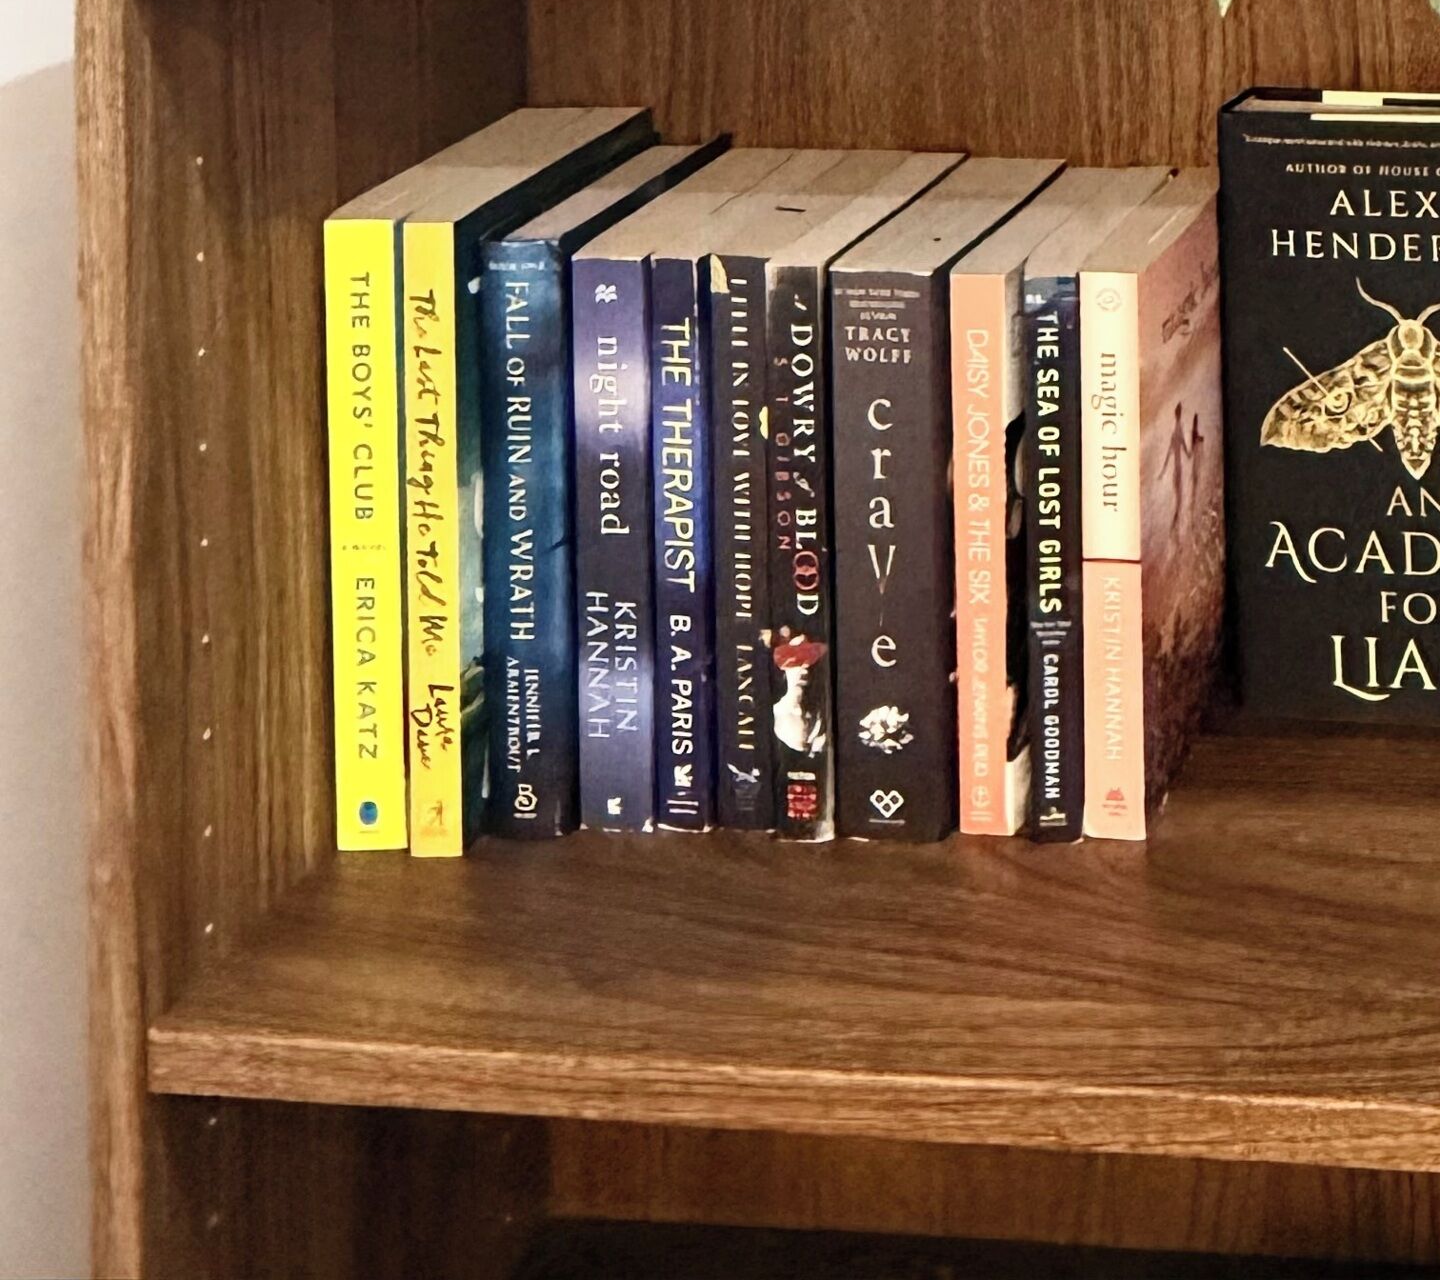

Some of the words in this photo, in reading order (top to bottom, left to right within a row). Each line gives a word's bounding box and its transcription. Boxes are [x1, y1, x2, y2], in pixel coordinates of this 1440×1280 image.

[350, 271, 371, 329] THE
[504, 281, 531, 349] FALL
[844, 326, 911, 343] TRACY
[1036, 310, 1060, 358] THE
[352, 344, 373, 428] BOYS'
[413, 344, 443, 406] Last
[506, 357, 526, 387] OF
[589, 336, 629, 433] night
[661, 317, 692, 387] THE
[845, 346, 912, 364] WOLFF
[966, 329, 990, 398] DAISY
[791, 324, 816, 463] DOWRY
[1037, 368, 1060, 416] SEA
[1090, 352, 1125, 434] magic
[506, 396, 532, 464] RUIN
[967, 405, 990, 489] JONES
[1038, 426, 1060, 457] OF
[353, 443, 374, 520] CLUB
[508, 473, 528, 521] AND
[599, 452, 630, 535] road
[662, 398, 696, 593] THERAPIST
[968, 494, 991, 512] &
[1038, 467, 1061, 529] LOST
[1101, 446, 1127, 512] hour
[968, 519, 991, 562] THE
[509, 529, 535, 640] WRATH
[968, 570, 991, 604] SIX
[1039, 539, 1063, 614] GIRLS
[355, 577, 376, 667] ERICA
[669, 614, 692, 637] B.
[1102, 576, 1123, 662] KRISTIN
[586, 591, 611, 738] HANNAH
[614, 601, 638, 732] KRISTIN
[670, 645, 693, 671] A.
[1043, 653, 1060, 709] CAROL
[356, 681, 378, 759] KATZ
[671, 679, 694, 755] PARIS
[1104, 667, 1124, 761] HANNAH
[1043, 714, 1061, 799] GOODMAN
